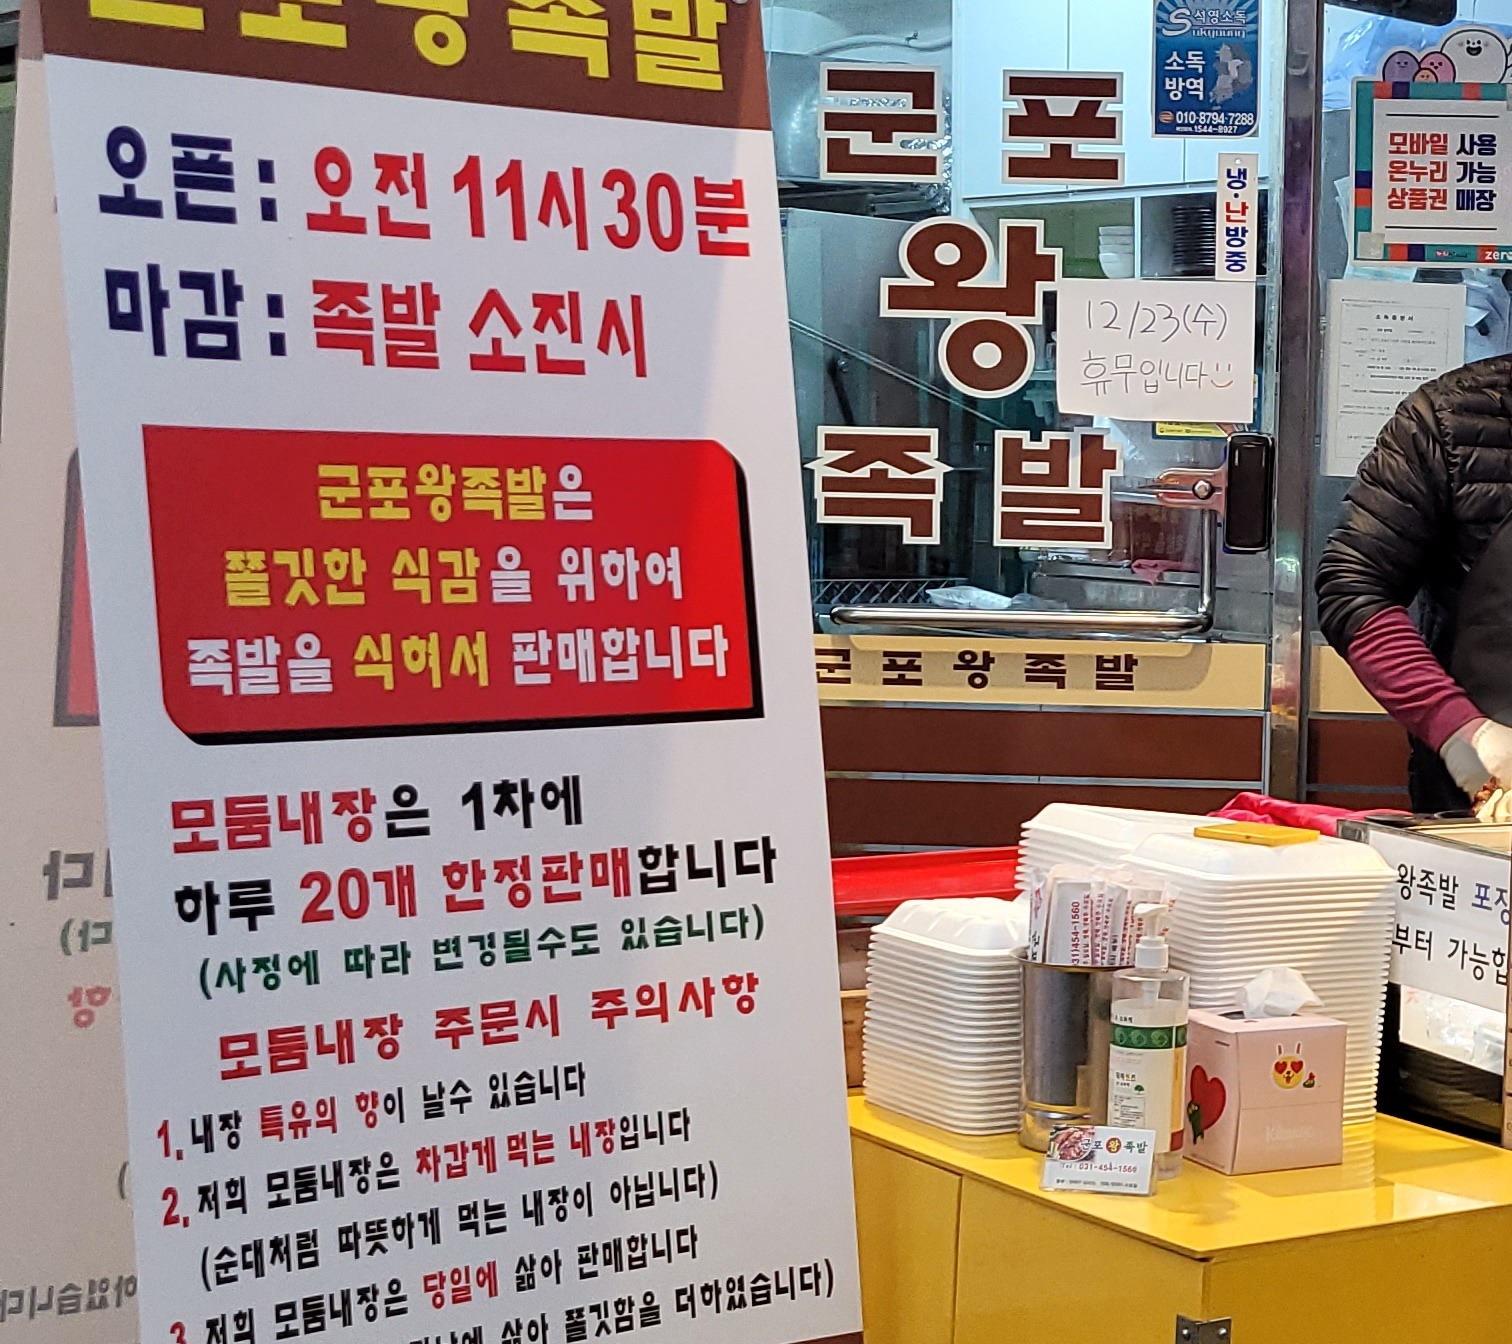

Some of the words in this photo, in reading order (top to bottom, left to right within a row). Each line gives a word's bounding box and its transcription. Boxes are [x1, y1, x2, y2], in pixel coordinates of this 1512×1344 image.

[1194, 9, 1246, 24] 석영소독
[1164, 50, 1206, 73] 소독
[1165, 77, 1204, 101] 방역
[1175, 111, 1254, 125] 010-8794-7288
[1387, 131, 1449, 157] 모바일
[1455, 132, 1497, 157] 사용
[306, 145, 430, 240] 오전
[1387, 160, 1448, 185] 온누리
[1455, 160, 1496, 185] 가능
[1387, 187, 1448, 212] 상품권
[1455, 188, 1496, 213] 매장
[311, 279, 441, 368] 족발
[469, 286, 647, 378] 소진시
[880, 217, 1062, 399] 왕
[1086, 299, 1229, 344] 12/23(수)
[1081, 349, 1208, 394] 휴무입니다
[317, 463, 593, 523] 군포왕족발은
[224, 546, 366, 606] 쫄깃한
[391, 545, 533, 605] 식감을
[557, 545, 683, 602] 위하여
[187, 632, 333, 696] 족발을
[353, 630, 489, 691] 식혀서
[511, 624, 729, 686] 판매합니다
[815, 648, 1139, 691] 군포왕족발
[170, 782, 431, 854] 모둠내장은
[461, 774, 584, 831] 1차에
[174, 878, 276, 937] 하루
[300, 863, 418, 924] 20개
[442, 834, 778, 913] 한정판매합니다
[1394, 863, 1459, 911] 왕족발
[199, 949, 320, 1000] (사정에
[344, 940, 412, 980] 따라
[432, 922, 601, 972] 변경될수도
[620, 903, 765, 953] 있습니다)
[1392, 923, 1433, 961] 부터
[218, 1012, 404, 1081] 모둠내장
[434, 994, 560, 1050] 주문시
[590, 971, 760, 1031] 주의사항
[157, 1119, 184, 1161] 1.
[190, 1109, 242, 1154] 내장
[259, 1096, 338, 1142] 특유의
[355, 1086, 405, 1129] 향이
[422, 1078, 473, 1121] 날수
[488, 1061, 587, 1109] 있습니다
[161, 1186, 190, 1228] 2.
[197, 1175, 248, 1219] 저희
[266, 1150, 401, 1210] 모둠내장은
[415, 1135, 498, 1183] 차갑게
[506, 1129, 556, 1168] 먹는
[568, 1107, 691, 1159] 내장입니다
[200, 1228, 320, 1292] (순대처럼
[338, 1206, 442, 1260] 따뜻하게
[458, 1197, 508, 1238] 먹는
[522, 1180, 593, 1227] 내장이
[609, 1159, 720, 1211] 아닙니다)
[275, 1277, 409, 1341] 모둠내장은
[422, 1260, 499, 1310] 당일에
[515, 1248, 562, 1293] 삶아
[577, 1224, 698, 1281] 판매합니다
[565, 1289, 661, 1344] 쫄깃함을
[675, 1257, 835, 1319] 더하였습니다)
